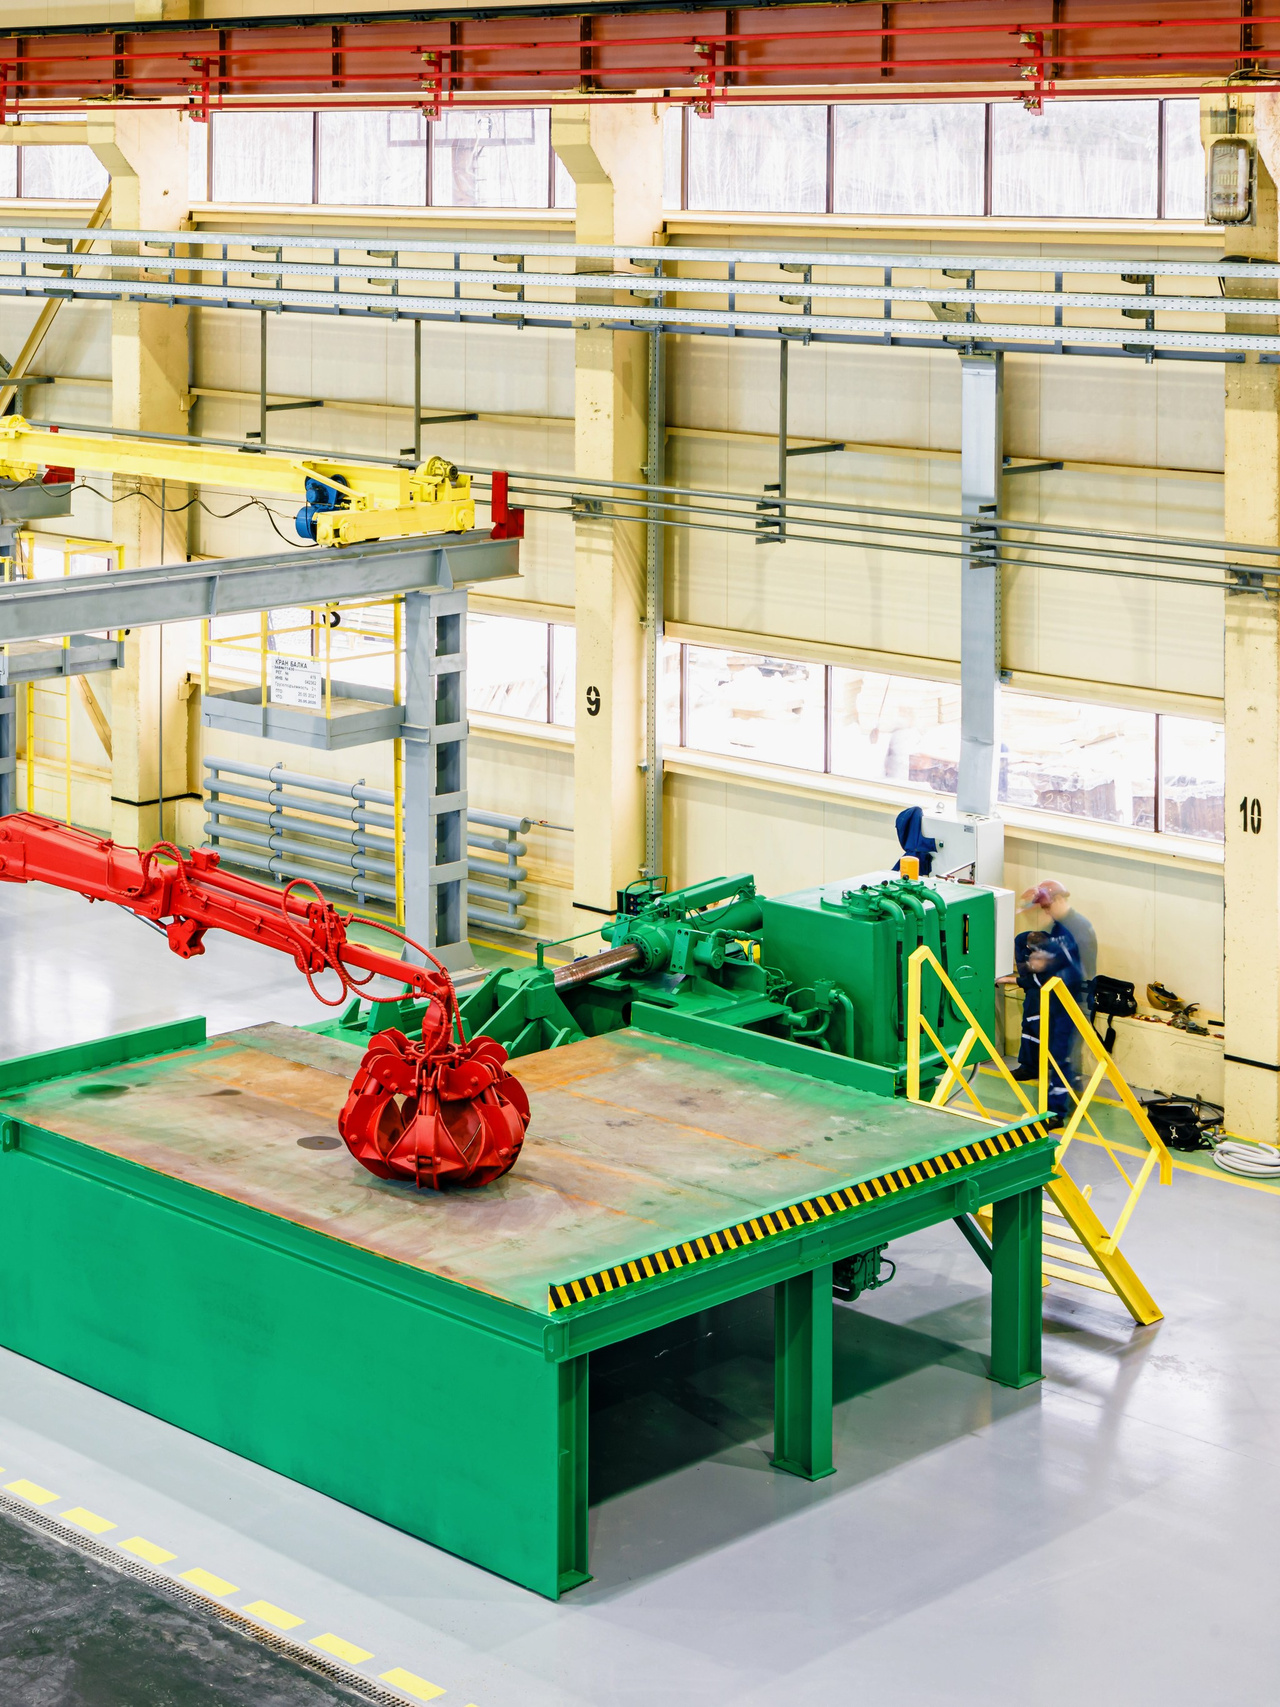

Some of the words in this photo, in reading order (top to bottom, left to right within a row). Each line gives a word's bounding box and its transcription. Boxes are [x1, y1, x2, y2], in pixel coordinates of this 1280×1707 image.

[291, 661, 308, 669] БАЛКА
[587, 686, 601, 716] 9
[1240, 796, 1262, 835] 10
